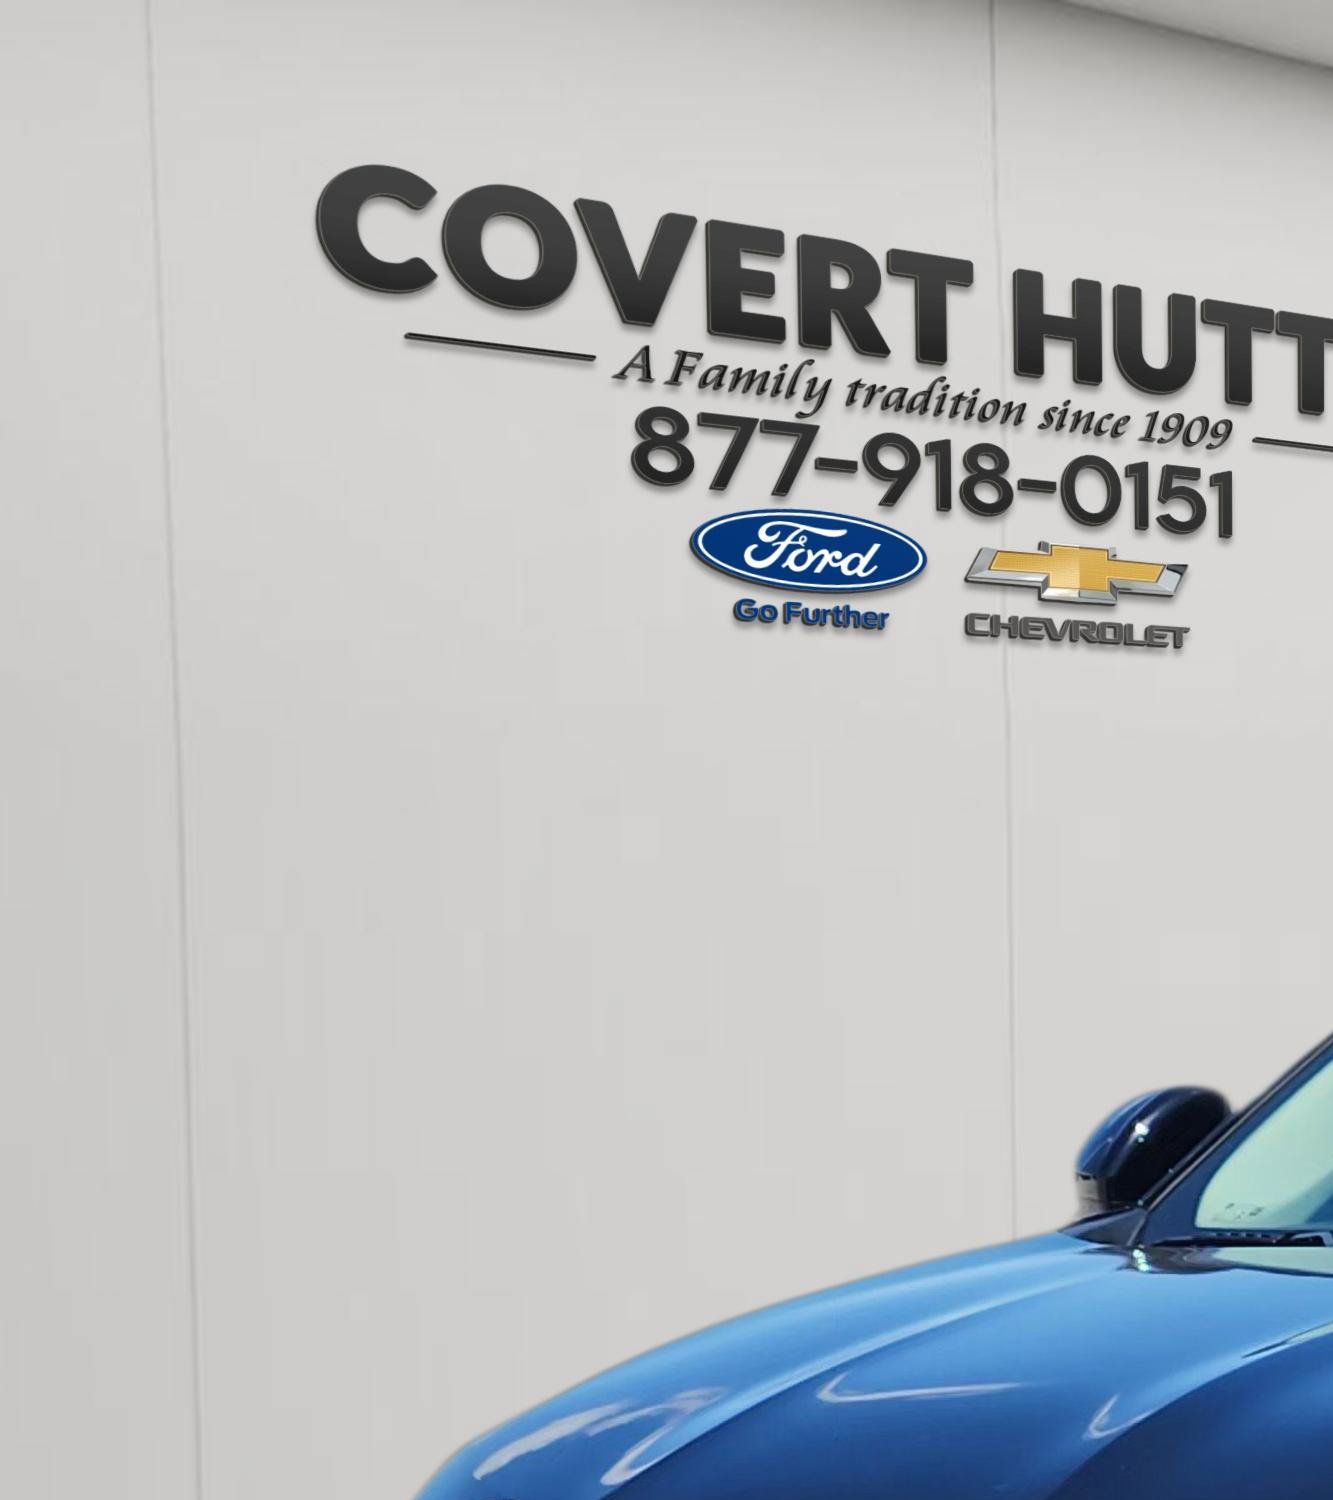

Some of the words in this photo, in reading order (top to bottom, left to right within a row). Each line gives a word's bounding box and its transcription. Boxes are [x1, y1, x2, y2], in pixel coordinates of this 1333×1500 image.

[314, 163, 975, 368] COVERT
[612, 344, 656, 384] A
[663, 348, 832, 420] Family
[845, 373, 1028, 428] tradition
[1036, 401, 1131, 440] since
[1138, 409, 1233, 450] 1909
[630, 405, 1234, 541] 877-918-0151
[742, 520, 882, 579] Ford
[732, 597, 779, 625] Go
[782, 600, 891, 631] Further
[964, 612, 1191, 650] CHEVROLET
